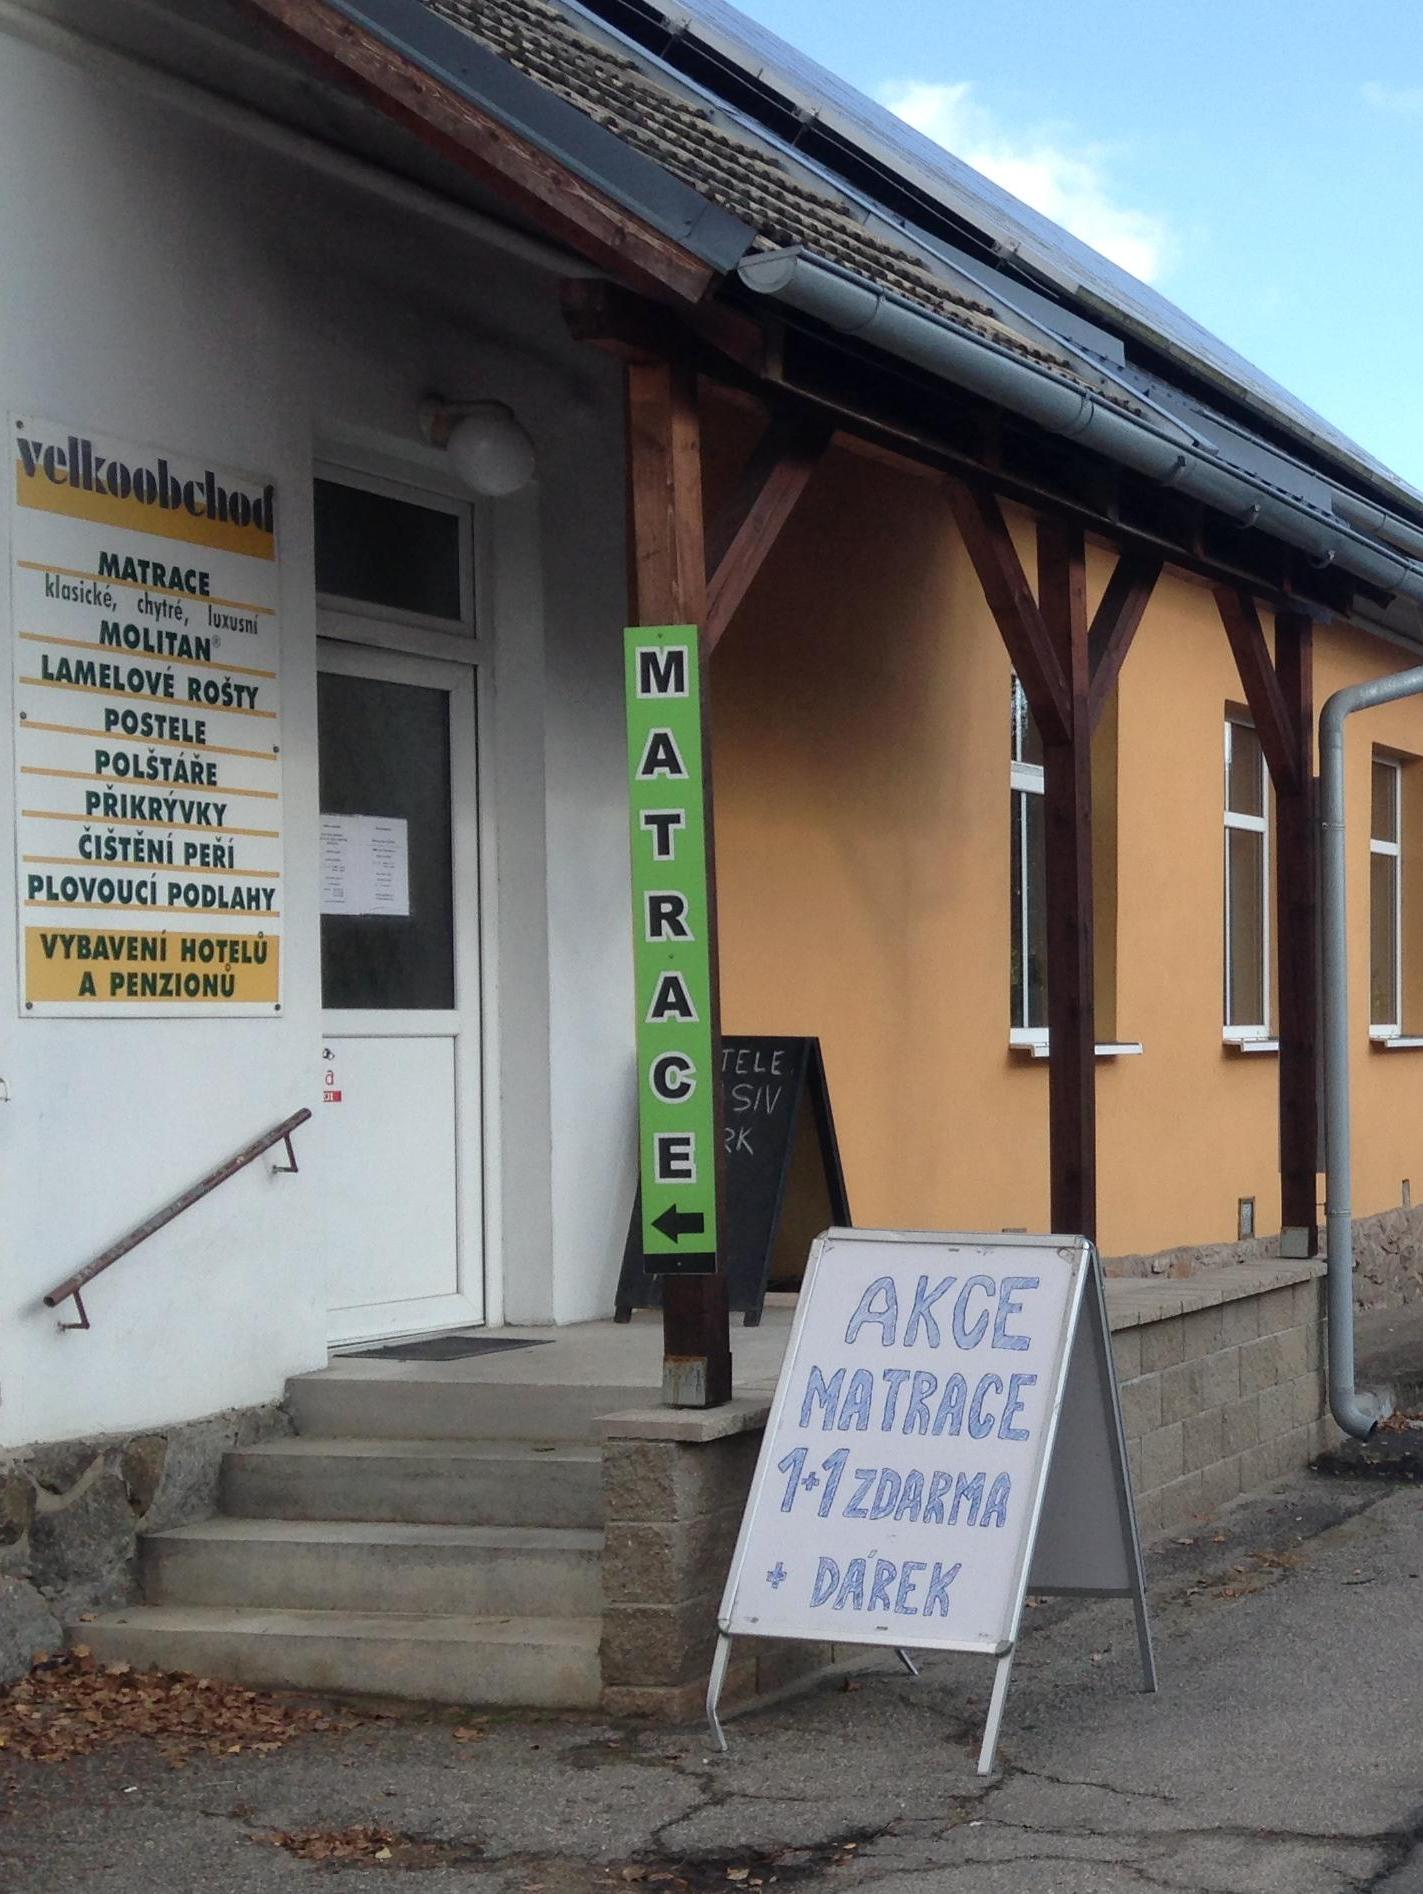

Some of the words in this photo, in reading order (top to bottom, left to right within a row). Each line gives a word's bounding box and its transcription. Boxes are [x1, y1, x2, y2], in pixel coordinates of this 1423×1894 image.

[16, 435, 276, 534] velkoobchod
[98, 550, 211, 597] MATRACE
[45, 572, 117, 612] klasické,
[137, 592, 189, 626] chytré,
[208, 604, 259, 635] luxusní
[41, 654, 175, 699] LAMELOVÉ
[187, 676, 259, 710] ROŠTY
[104, 708, 207, 745] POSTELE
[94, 747, 218, 786] POLŠTÁŘE
[85, 783, 227, 827] PŘIKRÝVKY
[78, 825, 174, 865] ČIŠTĚNÍ
[183, 836, 235, 869] PEŘÍ
[27, 872, 157, 905] PLOVOUCÍ
[167, 882, 276, 912] PODLAHY
[635, 646, 699, 1184] MATRACE
[39, 929, 167, 963] VYBAVENÍ
[180, 931, 268, 964] HOTELŮ
[78, 971, 96, 996] A
[110, 964, 236, 997] PENZIONŮ
[722, 1082, 782, 1114] SIV
[844, 1275, 1040, 1351] AKCE
[799, 1365, 1038, 1441] MATRACE
[842, 1467, 1012, 1528] ZDARMA
[810, 1549, 962, 1617] DÁREK
